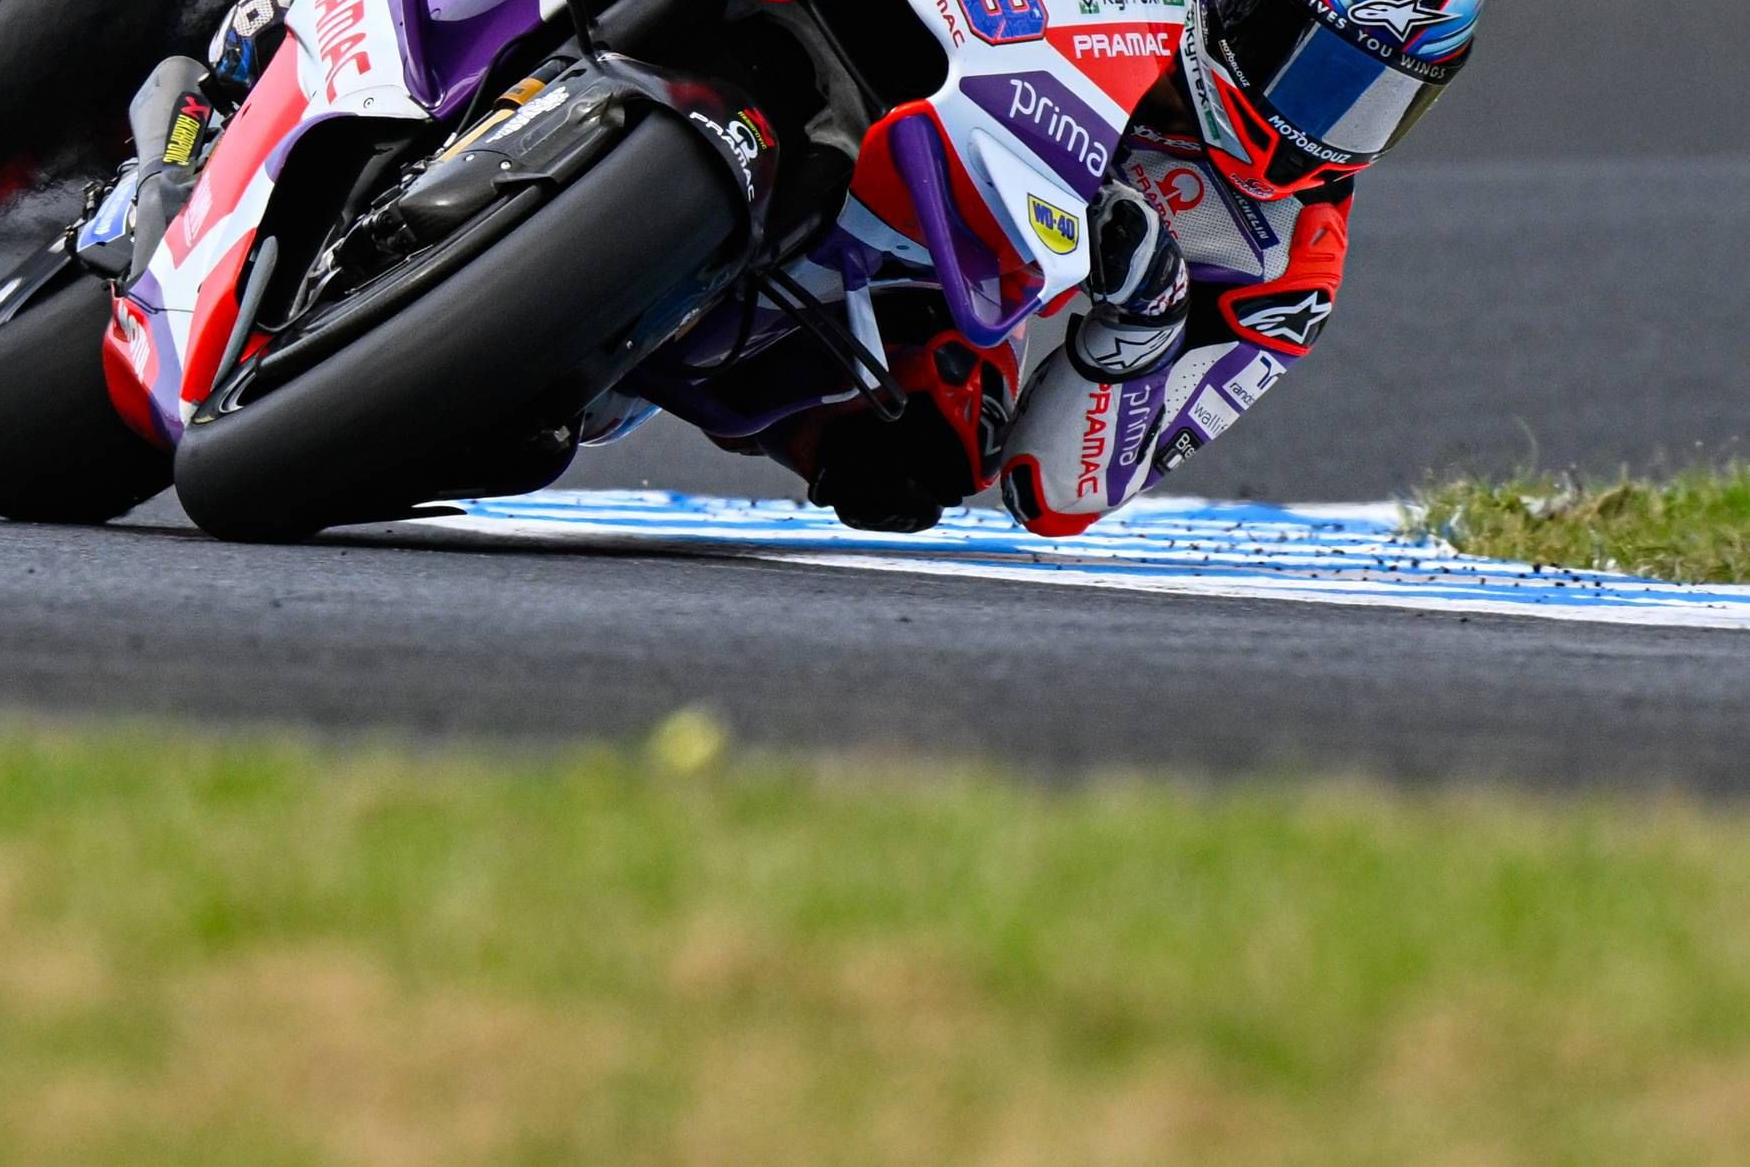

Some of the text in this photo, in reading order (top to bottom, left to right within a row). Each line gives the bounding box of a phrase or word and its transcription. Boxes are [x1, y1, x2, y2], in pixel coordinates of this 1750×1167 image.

[1072, 32, 1172, 59] PRAMAC
[1184, 26, 1210, 108] kyrrex
[1356, 29, 1394, 59] YOU
[1400, 53, 1448, 80] WINGS
[688, 110, 756, 203] PRAMAC
[1009, 78, 1109, 179] prima
[1268, 115, 1352, 164] MOTOBLOUZ
[1031, 199, 1076, 244] WD-40
[1230, 189, 1270, 240] ICHELIN
[1076, 383, 1114, 499] PRAMAC
[1119, 384, 1151, 467] prima
